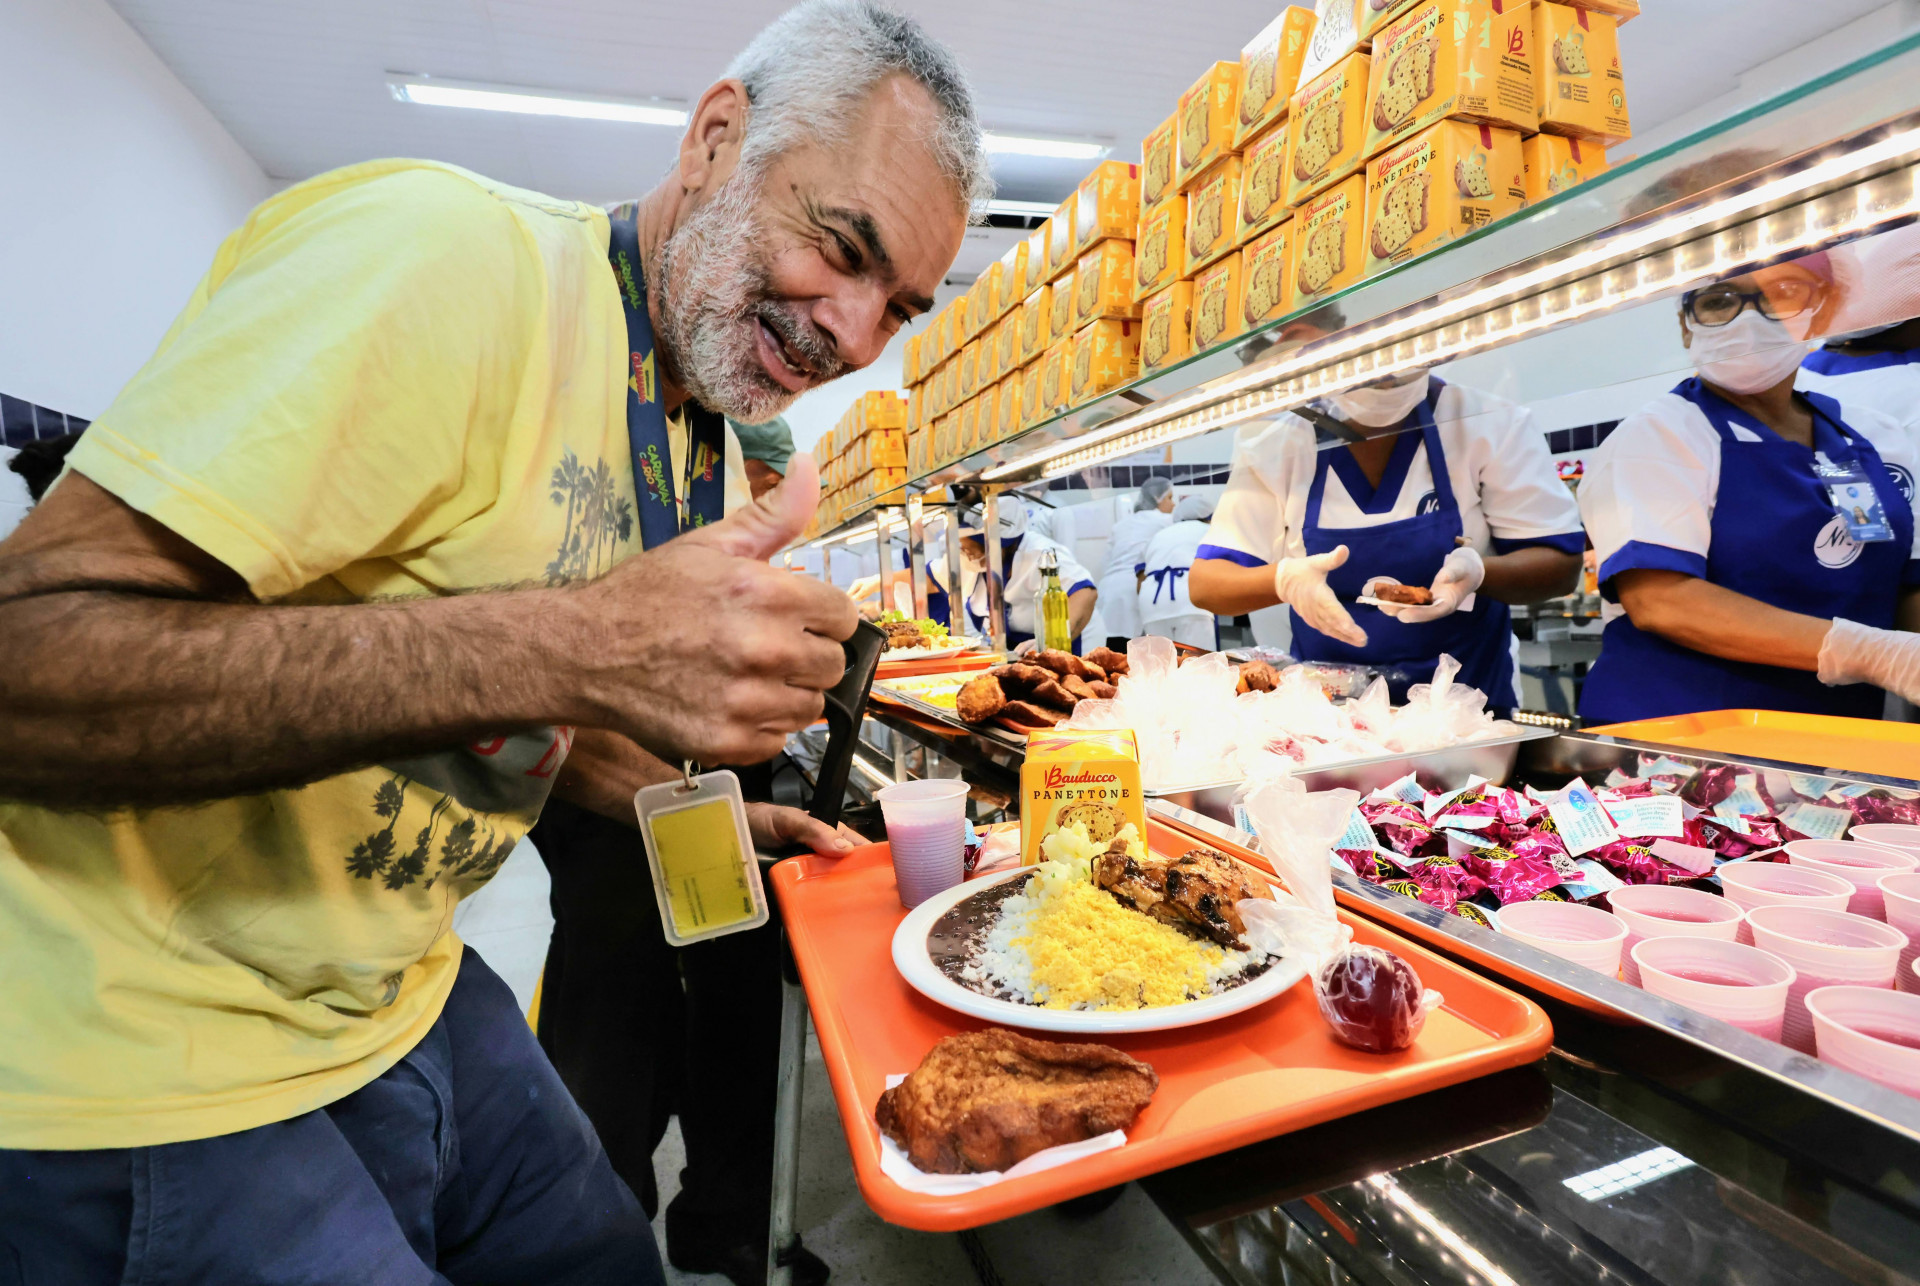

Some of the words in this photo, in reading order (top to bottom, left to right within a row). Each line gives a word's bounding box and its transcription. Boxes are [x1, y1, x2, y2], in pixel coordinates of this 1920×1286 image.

[1375, 13, 1445, 66] PANETTONE
[1385, 5, 1437, 48] Bauducco
[1292, 80, 1349, 123] PANETTONE
[1370, 150, 1437, 193] PANETTONE
[1377, 141, 1428, 179] Bauducco
[1297, 200, 1351, 236] PANETTONE
[1304, 192, 1344, 221] Bauducco
[618, 250, 642, 310] CARNAVAL
[647, 444, 672, 507] CARNAVAL
[1034, 789, 1130, 799] PANETTONE
[1044, 764, 1117, 789] Bauducco
